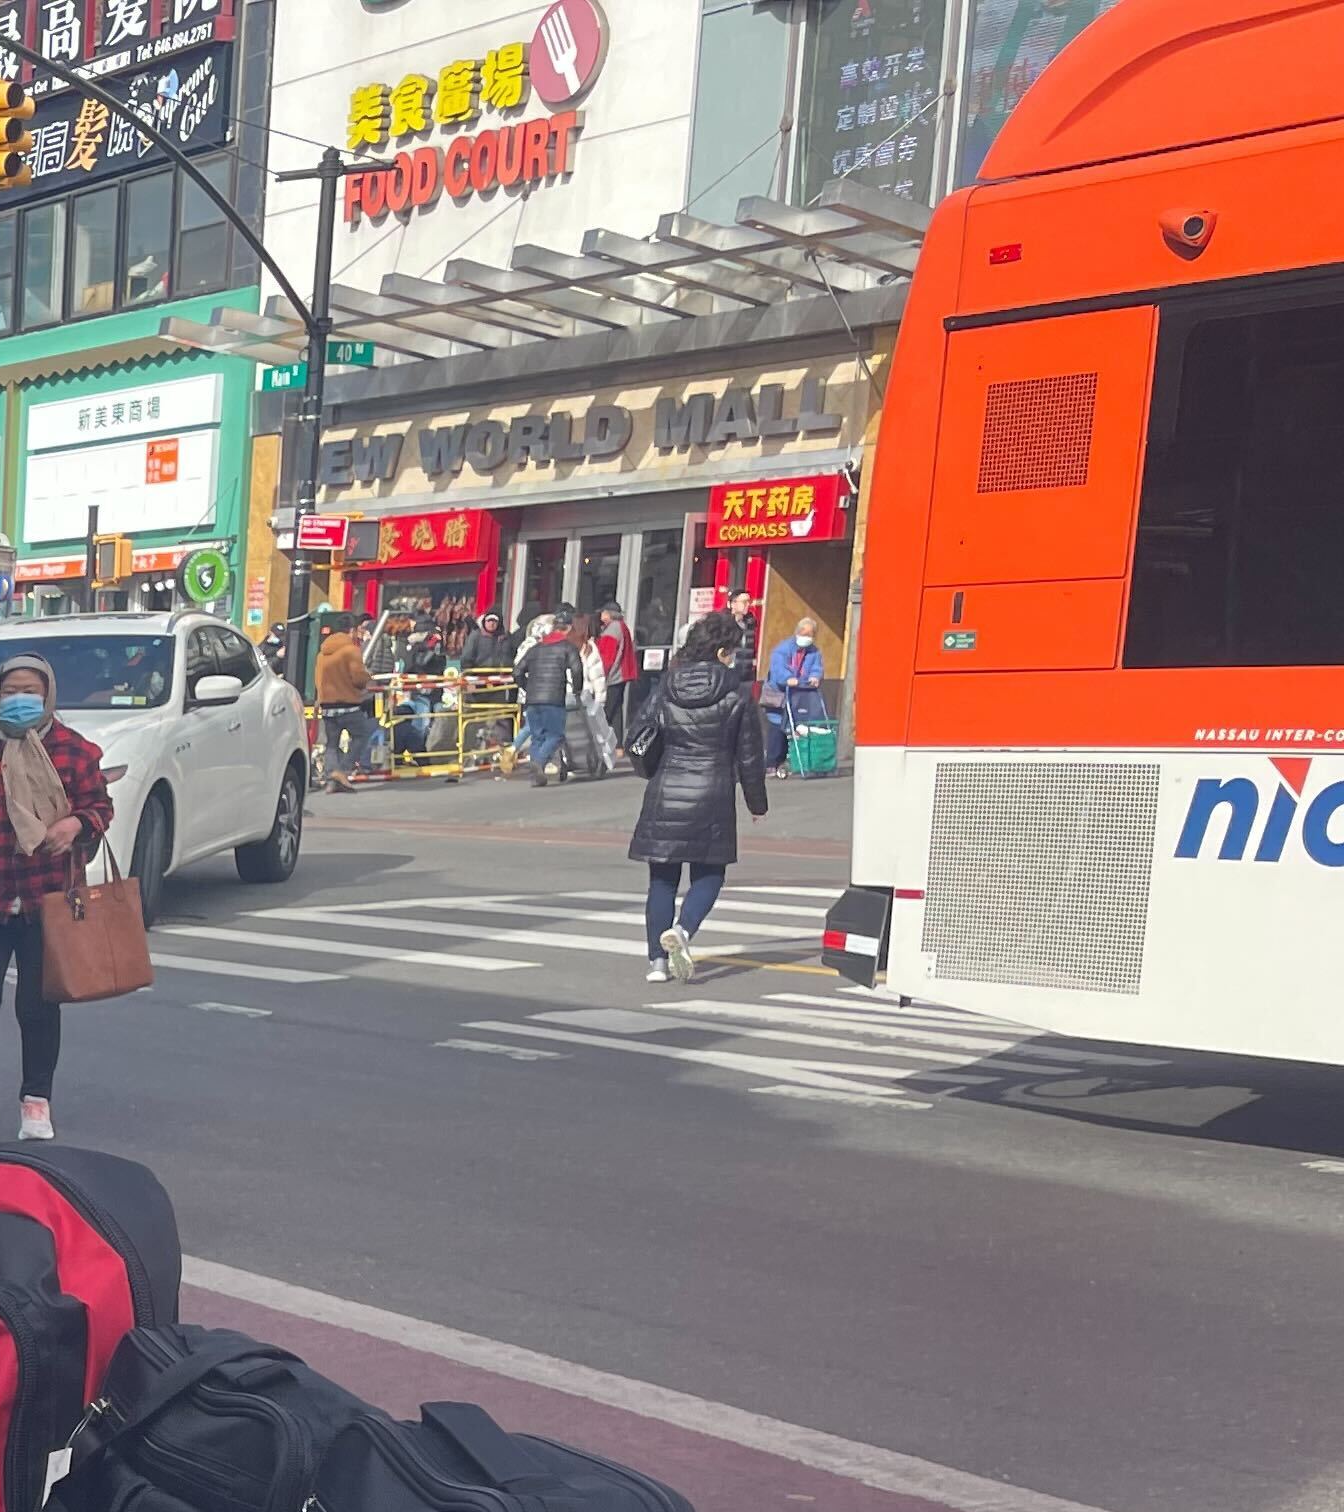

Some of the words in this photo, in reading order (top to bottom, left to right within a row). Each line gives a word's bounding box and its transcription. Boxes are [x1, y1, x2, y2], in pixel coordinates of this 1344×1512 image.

[347, 42, 524, 150] 美食廣場
[344, 146, 439, 223] FOOD
[444, 111, 578, 197] COURT
[336, 344, 353, 363] 40
[271, 368, 291, 388] Main
[320, 433, 406, 487] EW
[417, 405, 633, 481] WORLD
[654, 378, 842, 457] MALL
[722, 485, 815, 521] 天下药房
[719, 523, 788, 541] COMPASS
[1194, 728, 1260, 741] NASSAU
